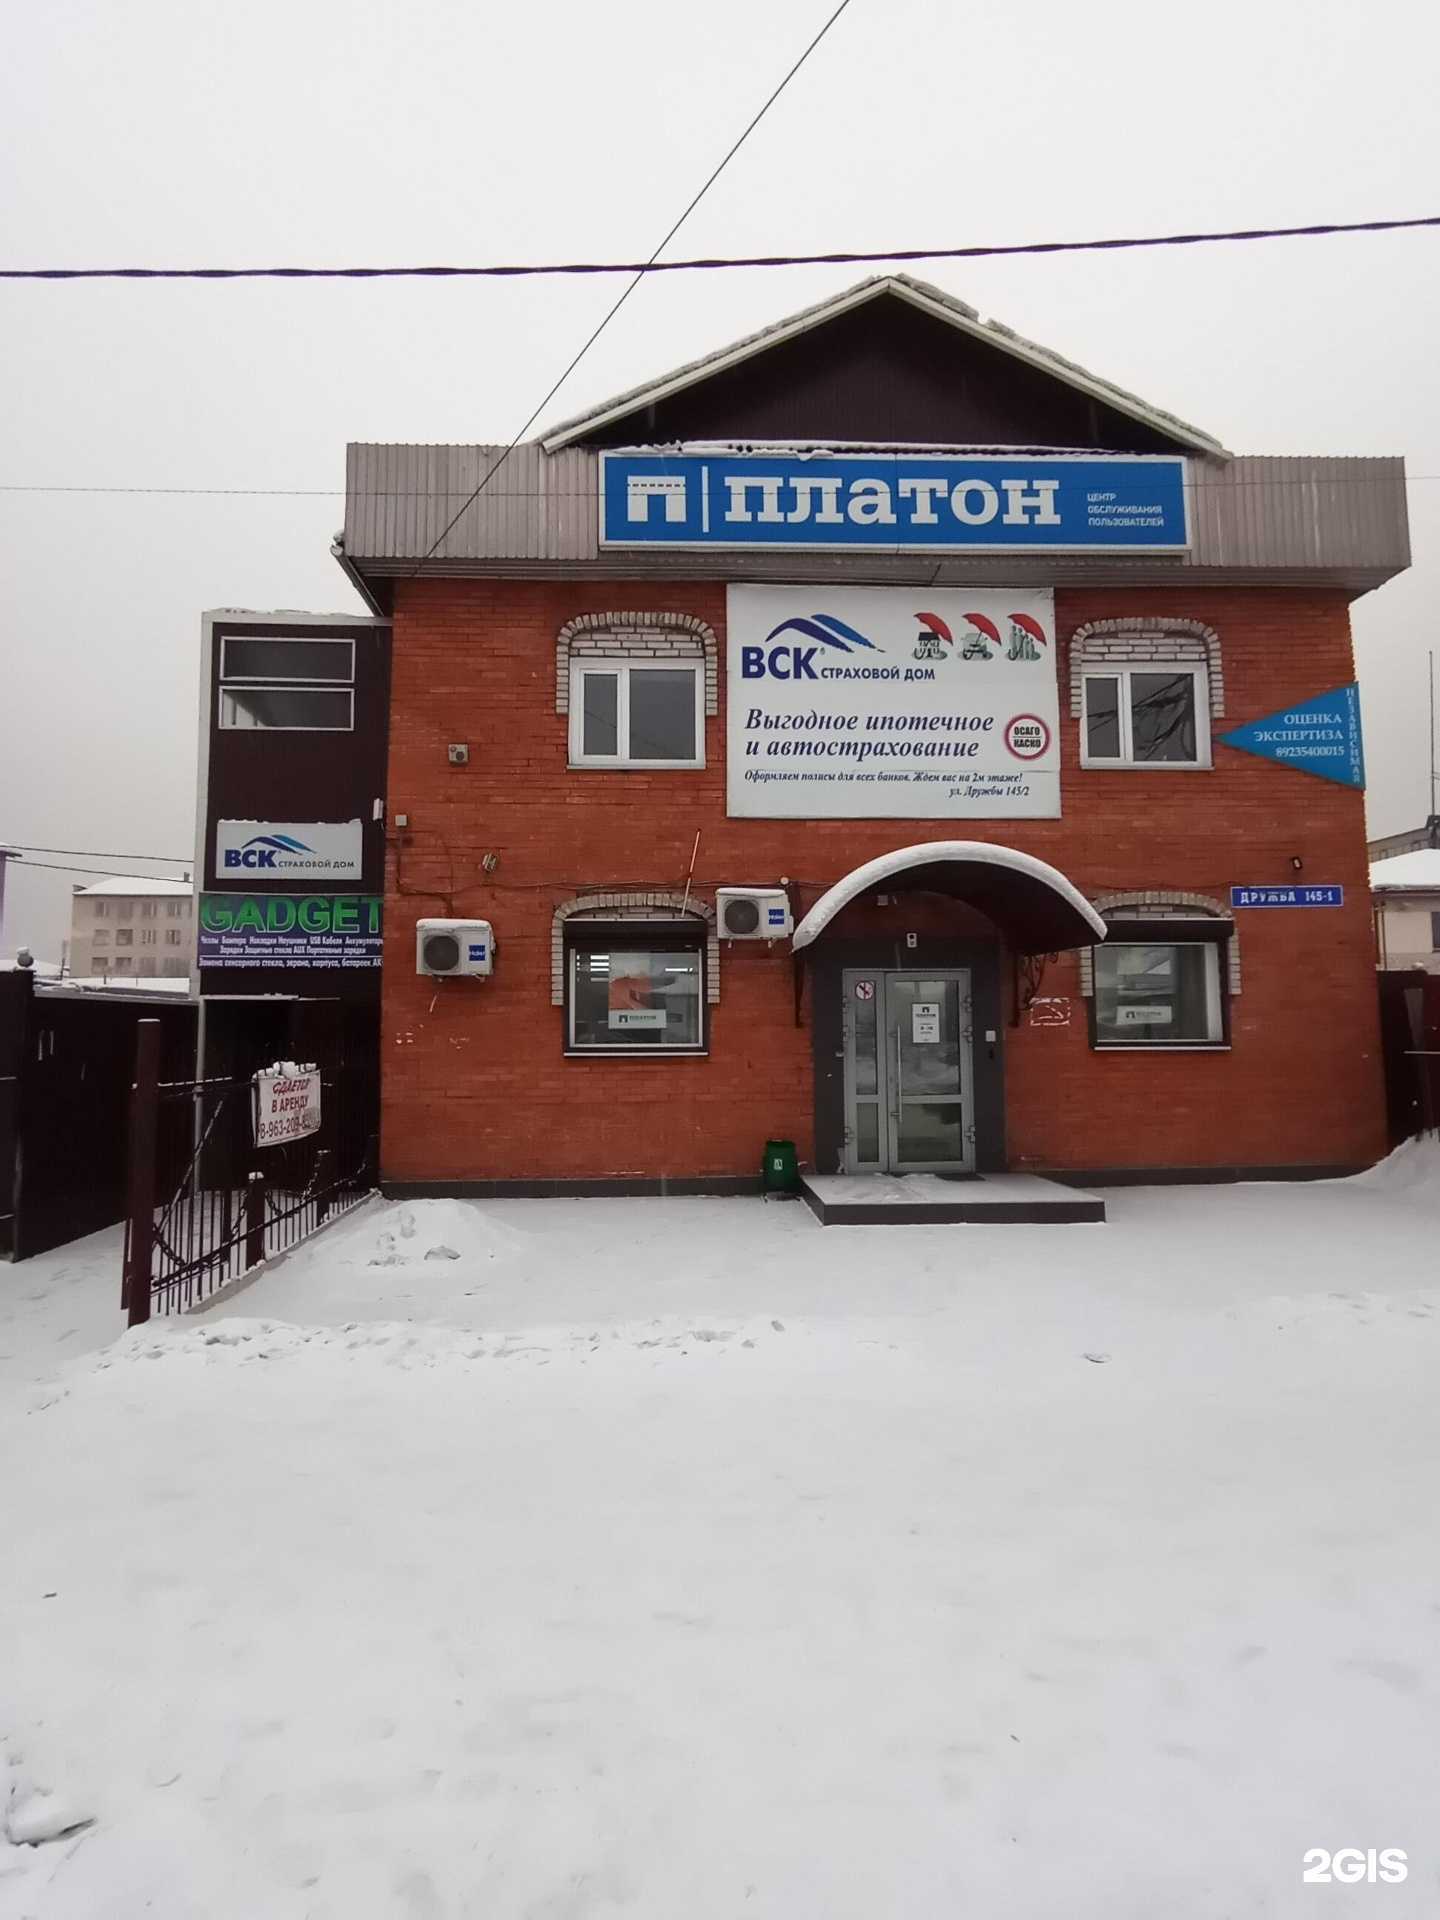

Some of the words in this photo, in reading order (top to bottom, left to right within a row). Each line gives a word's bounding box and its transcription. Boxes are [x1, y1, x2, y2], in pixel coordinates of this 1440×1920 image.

[1087, 493, 1117, 502] ЦЕНТР
[1087, 505, 1163, 514] ОБСЛУЖИВАНИЯ
[1088, 516, 1165, 527] ПОЛЬЗОВАТЕЛЕЙ
[742, 646, 819, 680] ВСК
[821, 666, 900, 680] СТРАХОВОЙ
[904, 668, 936, 682] ДОМ
[744, 708, 859, 731] Выгодное
[865, 714, 994, 731] ипотечное
[1284, 713, 1342, 725] ОЦЕНКА
[1013, 726, 1041, 736] ОСАГО
[1254, 730, 1344, 742] ЭКСПЕРТИЗА
[1013, 739, 1042, 748] КАСКО
[745, 740, 760, 756] и
[766, 740, 980, 762] автострахование
[1275, 746, 1345, 757] 89235400015
[744, 769, 799, 783] Оформляем
[801, 772, 835, 781] полисы
[838, 771, 854, 781] для
[856, 773, 875, 781] всех
[912, 771, 940, 782] Ждем
[942, 774, 957, 782] вас
[958, 774, 970, 782] на
[972, 772, 985, 782] 2м
[987, 772, 1023, 783] этаже!
[948, 787, 962, 798] ул.
[963, 785, 1004, 798] Дружбы
[1006, 786, 1030, 796] 145/2
[224, 849, 278, 868] ВСК
[278, 860, 332, 868] СТРАХОВОЙ
[333, 861, 355, 869] ДОМ
[200, 896, 384, 933] GADGET
[271, 1099, 278, 1113] В
[279, 1095, 310, 1113] АРЕНДУ
